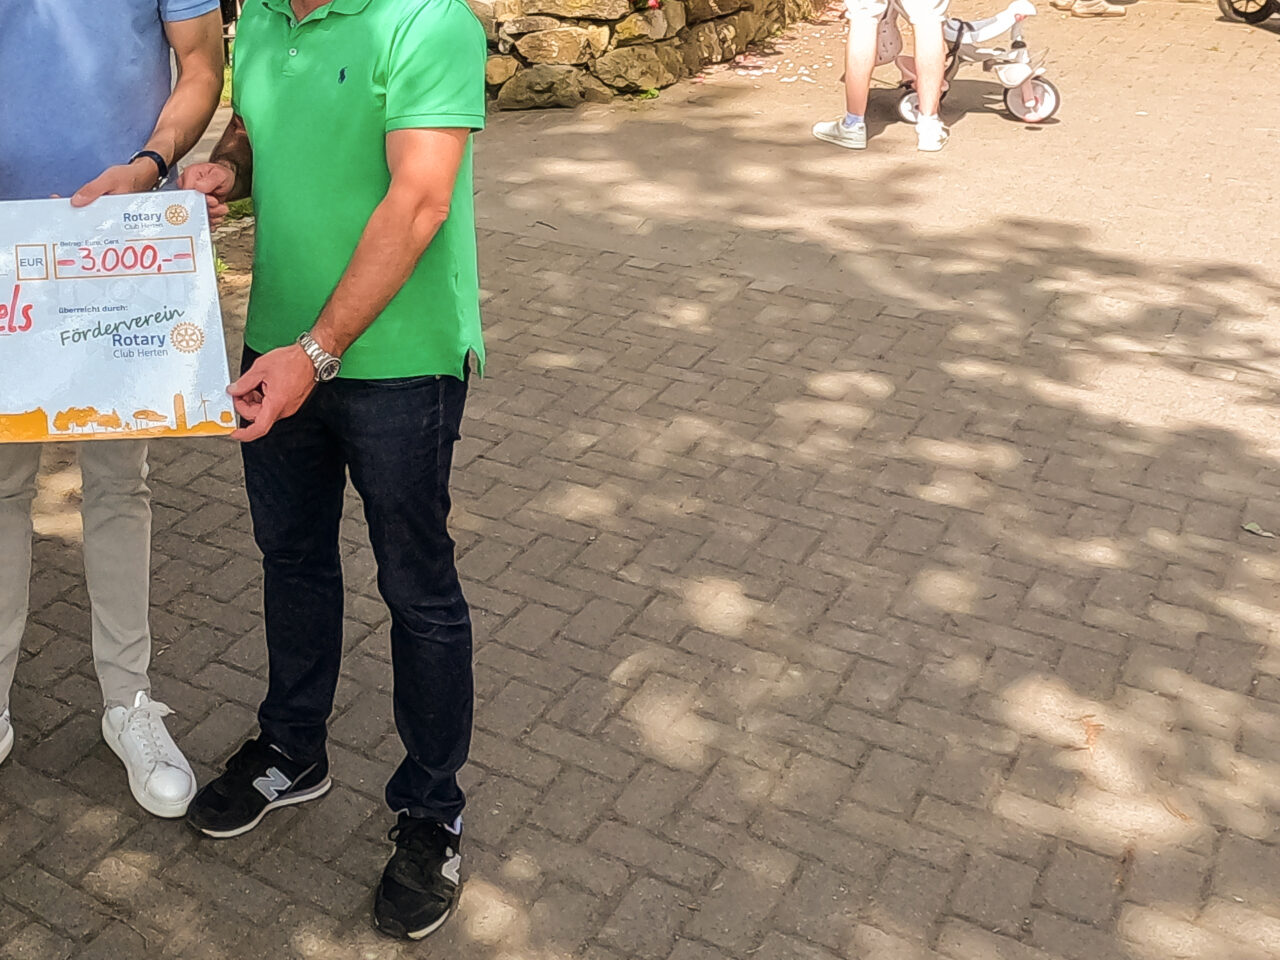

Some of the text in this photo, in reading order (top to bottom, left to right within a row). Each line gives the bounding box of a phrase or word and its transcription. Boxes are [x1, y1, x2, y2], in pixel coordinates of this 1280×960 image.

[123, 212, 162, 223] Rotary
[19, 257, 44, 268] EUR
[58, 304, 129, 314] überreicht durch:
[59, 305, 185, 346] Förderverein
[112, 333, 166, 348] Rotary
[113, 348, 169, 359] Club Herten
